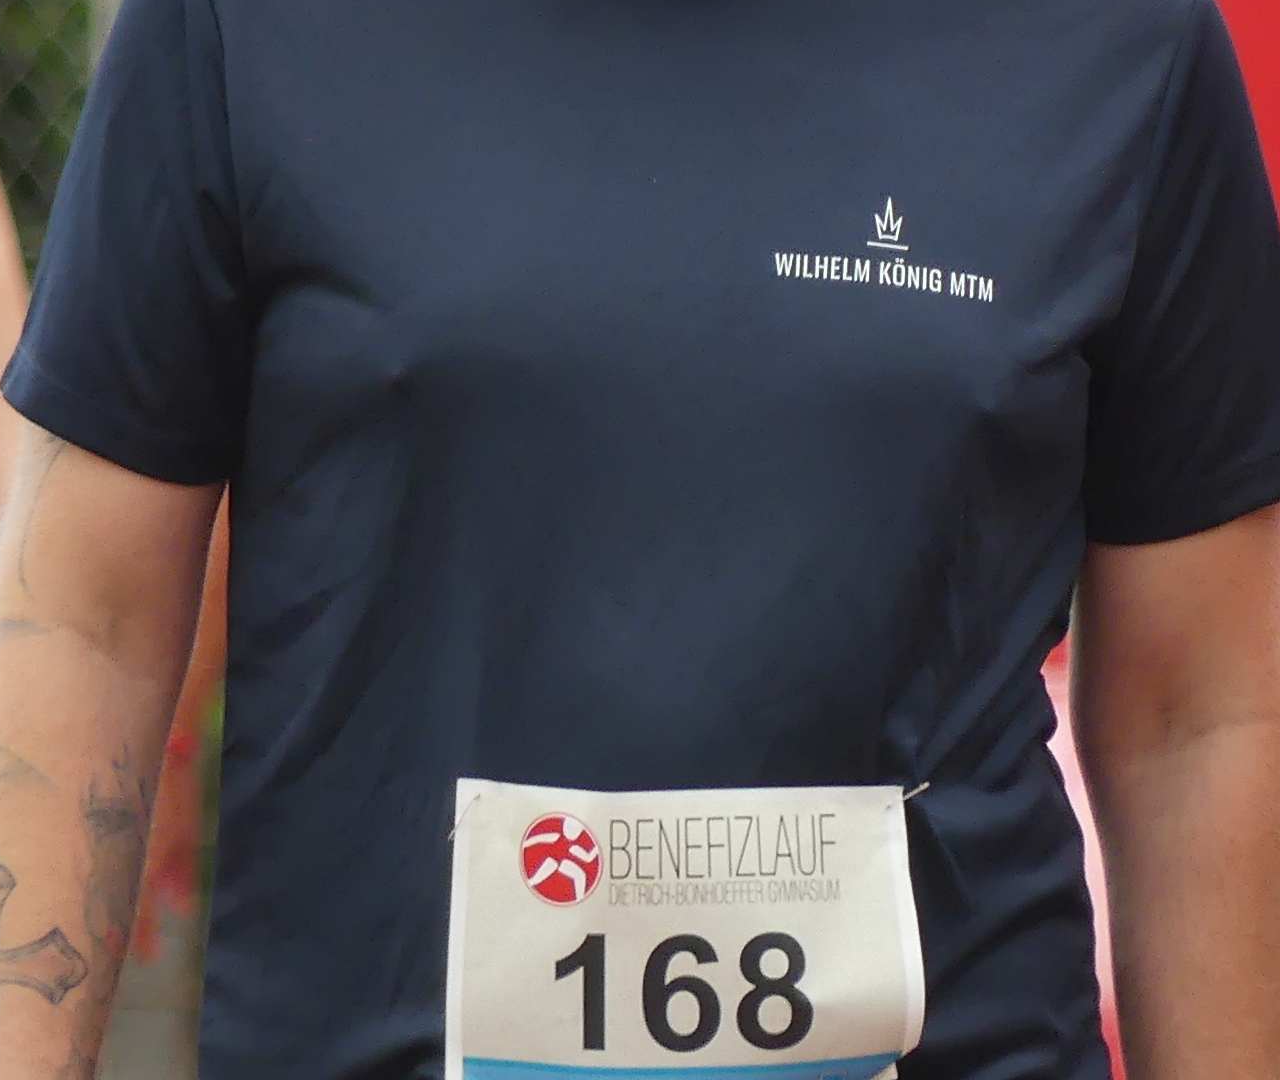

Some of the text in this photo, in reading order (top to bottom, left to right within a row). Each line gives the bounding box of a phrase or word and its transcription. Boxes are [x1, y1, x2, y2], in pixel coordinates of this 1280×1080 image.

[775, 252, 993, 302] WILHELM KÖNIG MTM
[609, 814, 837, 880] BENEFIZLAUF
[609, 878, 841, 906] DIETRICH-BONHOEFFER GYMNASIUM
[554, 932, 815, 1053] 168
